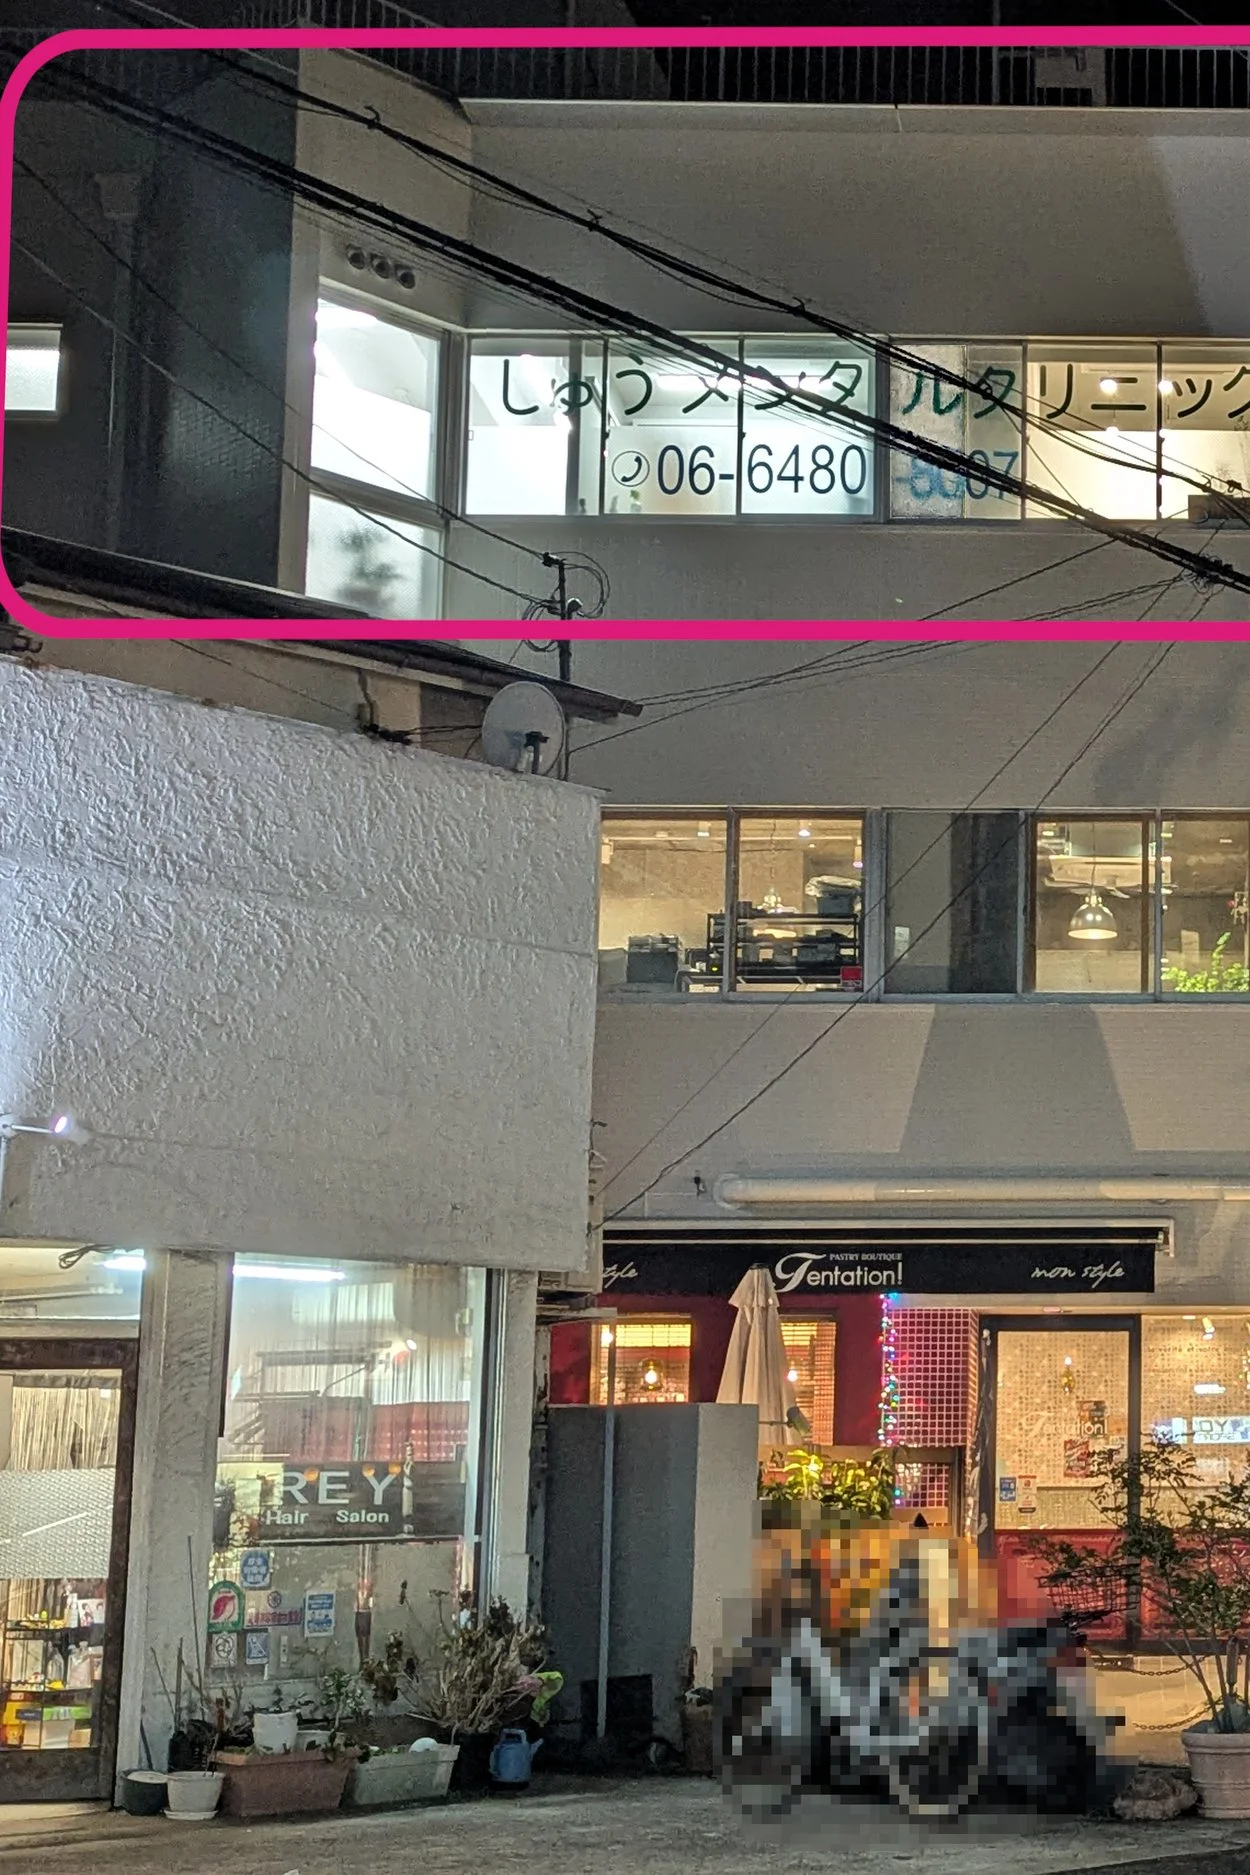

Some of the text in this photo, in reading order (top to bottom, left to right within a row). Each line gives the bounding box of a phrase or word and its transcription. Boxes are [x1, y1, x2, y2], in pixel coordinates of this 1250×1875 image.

[861, 1253, 902, 1261] BOUTIQUE
[603, 1262, 638, 1288] tyle
[775, 1252, 902, 1292] Tentation!
[1031, 1261, 1125, 1288] mon style
[265, 1509, 390, 1525] Hair Salon
